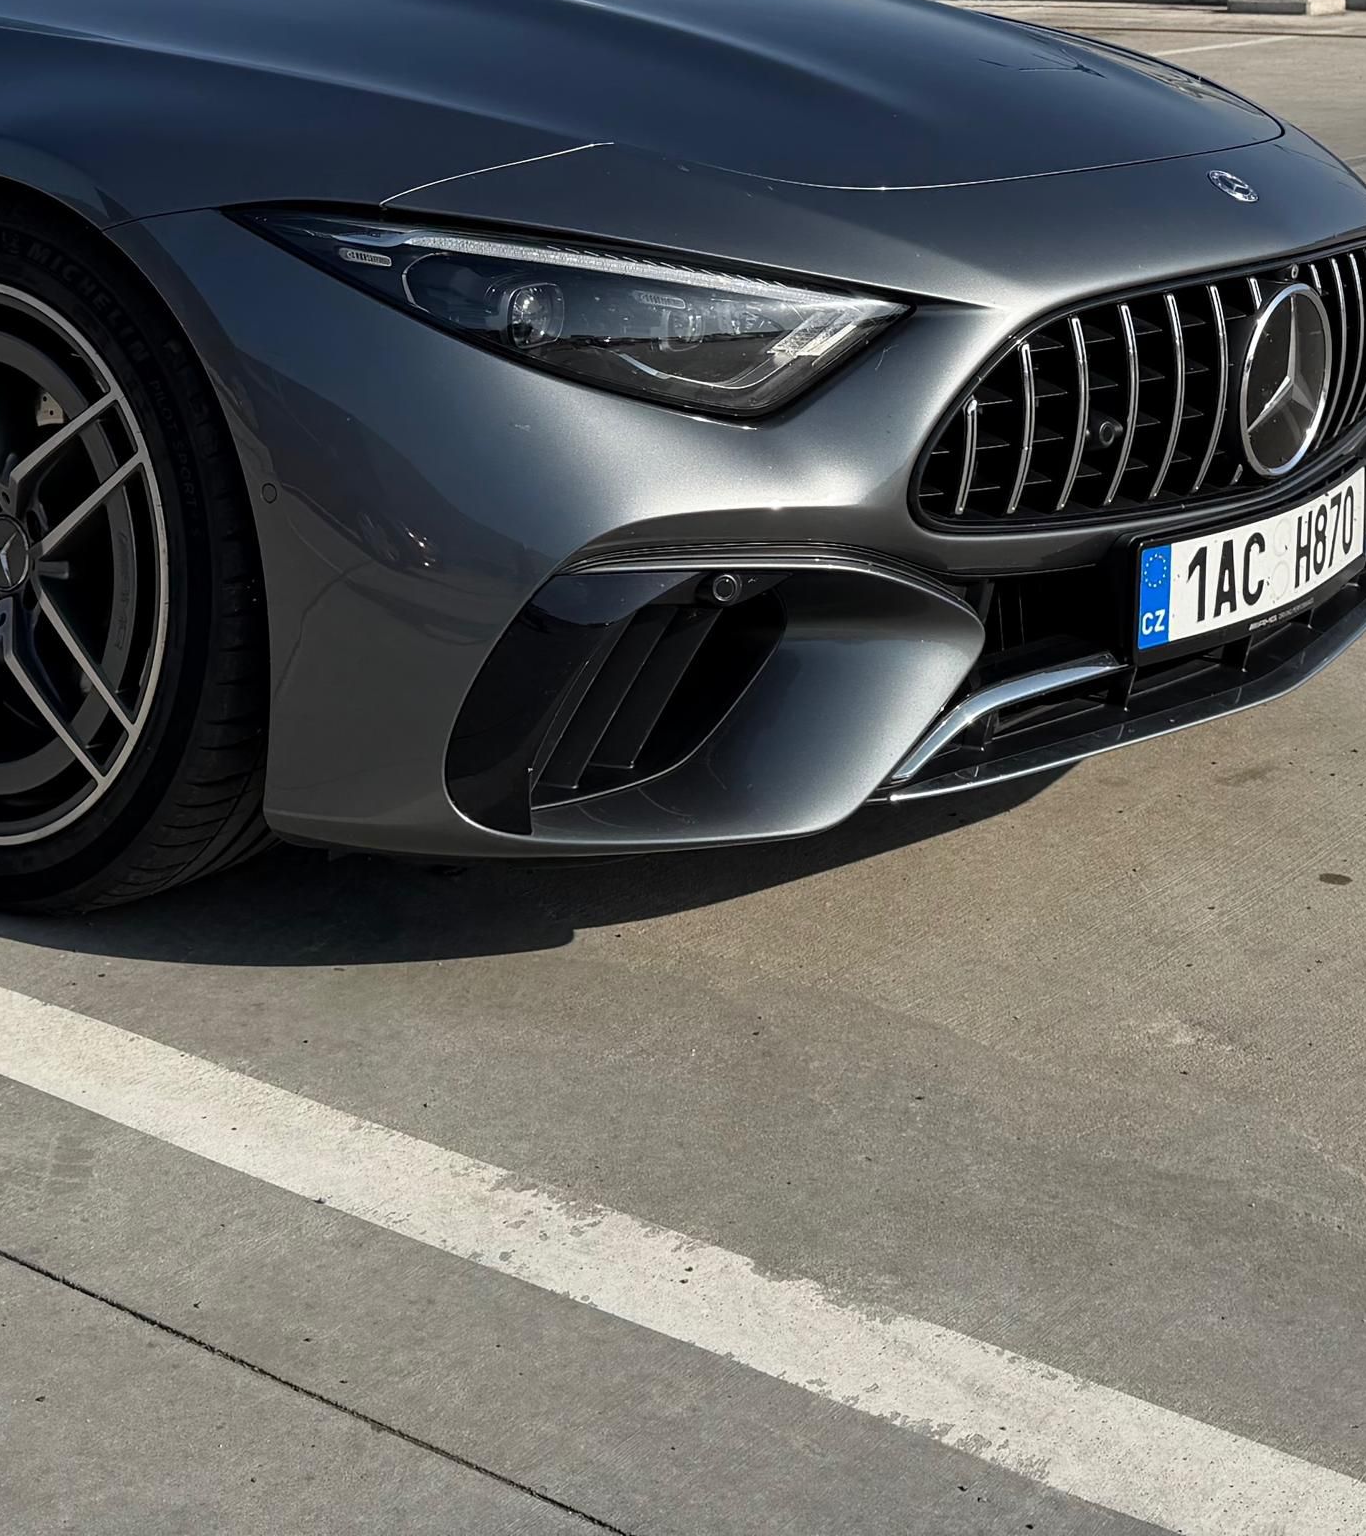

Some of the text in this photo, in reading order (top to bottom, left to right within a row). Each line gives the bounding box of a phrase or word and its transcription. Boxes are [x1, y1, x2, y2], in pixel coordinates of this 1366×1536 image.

[26, 241, 152, 367] MICHELIN
[148, 378, 180, 434] PILOT
[171, 437, 199, 507] SPORT
[1186, 486, 1354, 623] 1AC H870
[1142, 608, 1166, 636] CZ
